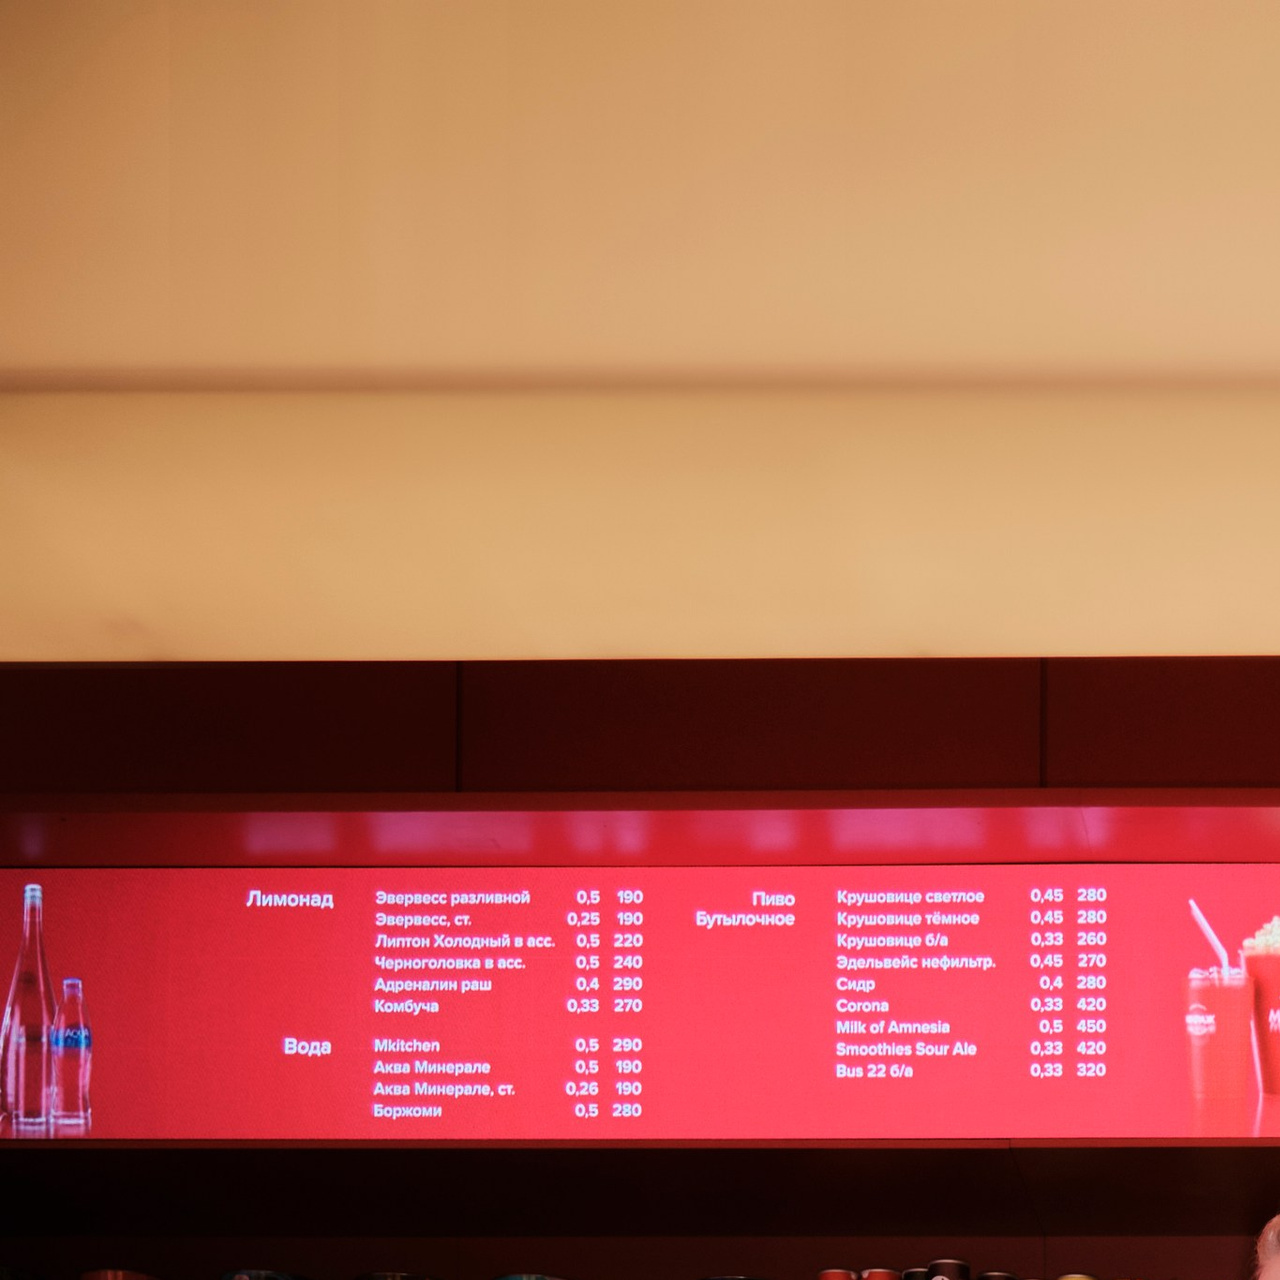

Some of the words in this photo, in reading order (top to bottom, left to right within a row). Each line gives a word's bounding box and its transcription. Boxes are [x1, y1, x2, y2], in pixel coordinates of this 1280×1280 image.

[246, 890, 335, 910] Лимонад
[375, 890, 448, 907] Эвервесс
[450, 890, 531, 907] разливной
[576, 889, 601, 906] 0,5
[617, 889, 644, 904] 190
[752, 891, 796, 907] Пиво
[837, 889, 923, 907] Крушовице
[925, 891, 985, 904] светлое
[1030, 888, 1064, 904] 0,45
[1077, 887, 1108, 902] 280
[375, 912, 451, 929] Эвервесс,
[453, 914, 472, 926] ст.
[566, 911, 601, 927] 0,25
[616, 911, 644, 926] 190
[696, 910, 796, 930] Бутылочное
[375, 933, 431, 948] Липтон
[433, 933, 511, 950] Холодный
[514, 936, 524, 948] в
[526, 936, 556, 948] асс.
[576, 933, 601, 949] 0,5
[613, 933, 644, 948] 220
[836, 954, 919, 971] Эдельвейс
[921, 954, 996, 971] нефильтр.
[1029, 953, 1064, 969] 0,45
[1078, 953, 1107, 968] 270
[374, 999, 440, 1016] Комбуча
[566, 998, 600, 1014] 0,33
[614, 998, 643, 1013] 270
[835, 998, 890, 1013] Corona
[1030, 997, 1064, 1013] 0,33
[1076, 997, 1107, 1012] 420
[836, 1020, 867, 1034] Milk
[869, 1020, 886, 1035] of
[887, 1019, 951, 1034] Amnesia
[1038, 1019, 1064, 1035] 0,5
[1076, 1019, 1107, 1033] 450
[284, 1037, 332, 1057] Вода
[374, 1038, 441, 1053] Mkitchen
[575, 1037, 600, 1054] 0,5
[612, 1038, 643, 1052] 290
[835, 1063, 864, 1078] Bus
[867, 1063, 887, 1078] 22
[889, 1063, 914, 1078] б/а
[1030, 1062, 1063, 1079] 0,33
[1076, 1062, 1107, 1077] 320
[373, 1081, 411, 1096] Аква
[414, 1081, 495, 1099] Минерале,
[497, 1084, 516, 1096] ст.
[565, 1081, 599, 1097] 0,26
[615, 1081, 643, 1096] 190
[373, 1103, 443, 1121] Боржоми
[574, 1103, 599, 1119] 0,5
[612, 1103, 642, 1118] 280
